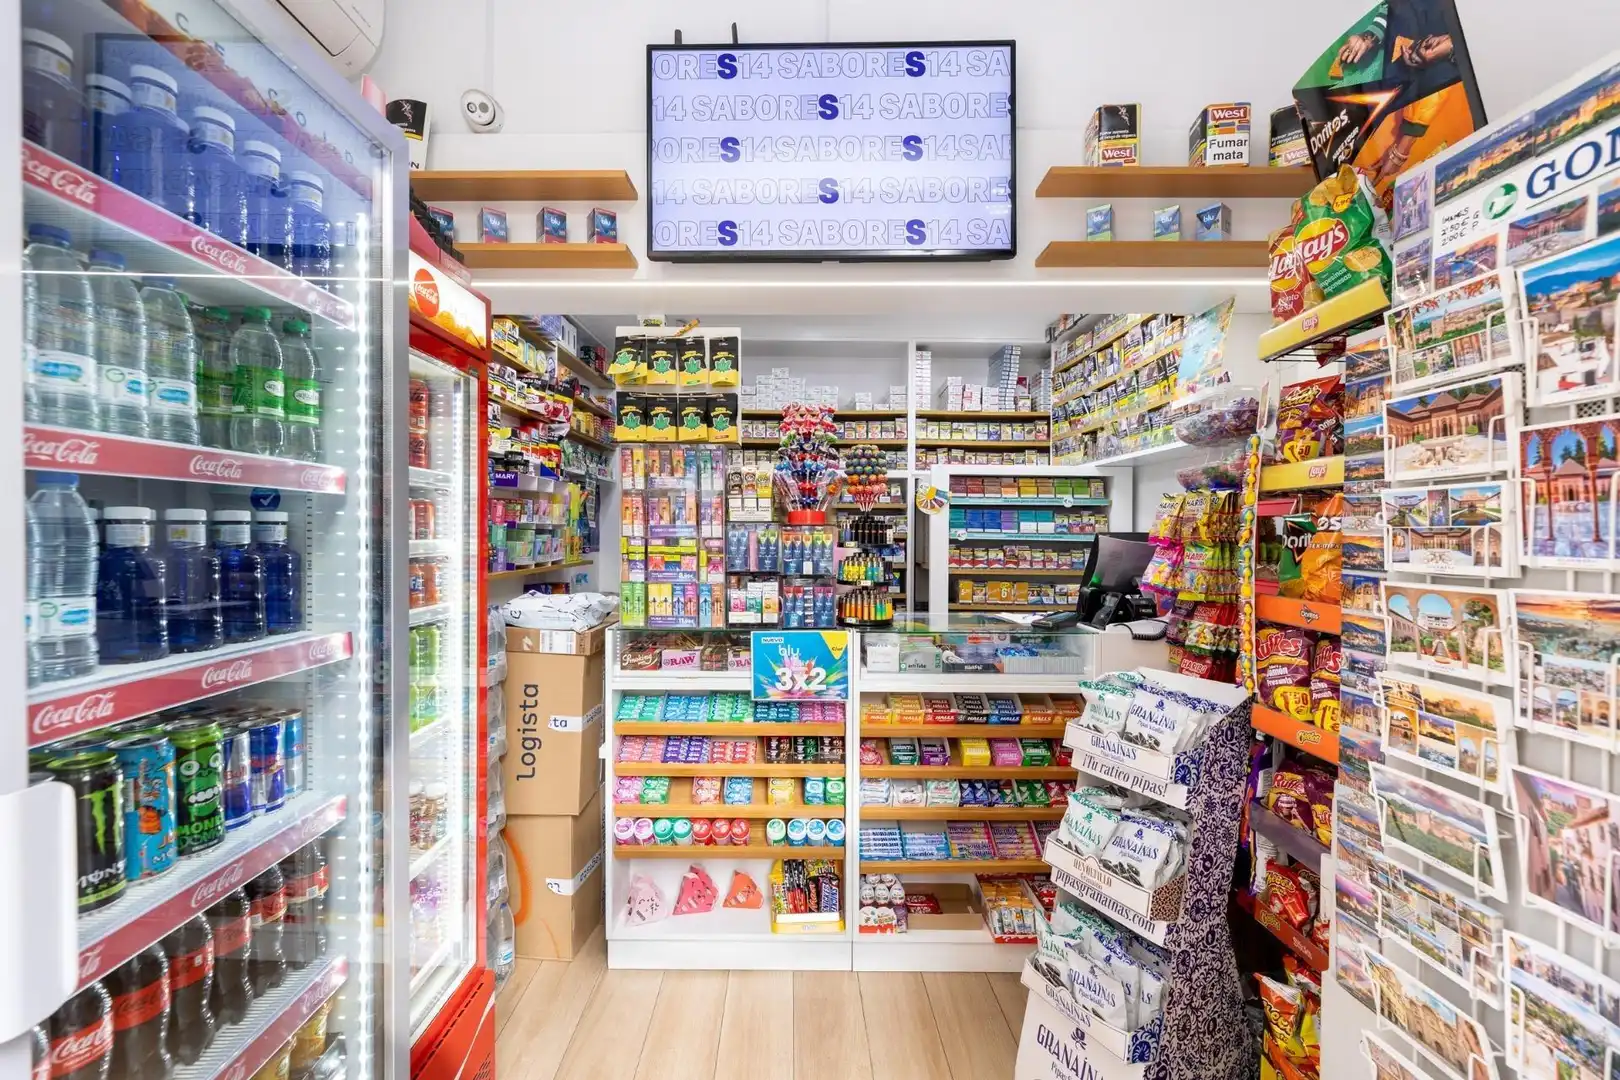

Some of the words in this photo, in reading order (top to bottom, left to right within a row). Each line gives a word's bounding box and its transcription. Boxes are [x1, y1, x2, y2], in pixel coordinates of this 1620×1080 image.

[879, 92, 1012, 120] SABORE
[1212, 107, 1246, 119] West
[1310, 108, 1348, 155] Doritos
[1209, 138, 1248, 149] Fumar
[1103, 149, 1131, 159] West
[1213, 151, 1244, 161] mata
[1286, 149, 1309, 160] Wes
[22, 152, 98, 205] oca-Cola
[879, 176, 1012, 204] SABORE
[1185, 551, 1208, 560] HARIBO
[622, 650, 657, 666] Smoking
[670, 655, 696, 666] RAW
[1181, 658, 1206, 675] HARIBO
[33, 692, 115, 735] Coca-Cola
[516, 683, 543, 781] Logista
[1099, 763, 1130, 783] ratico
[1131, 776, 1168, 798] pipas!
[1036, 1023, 1105, 1080] GRANAÍN
